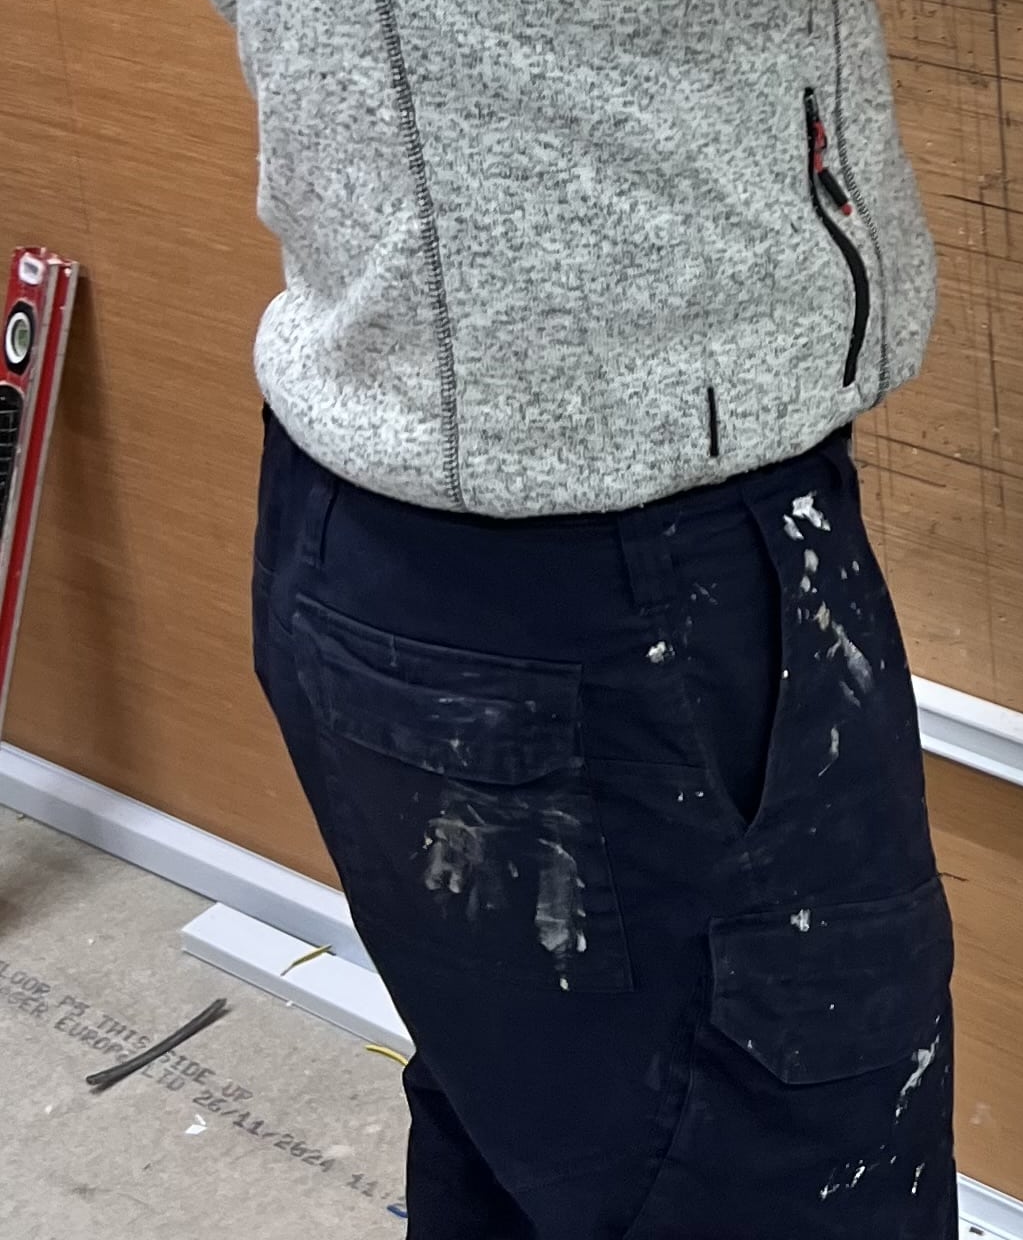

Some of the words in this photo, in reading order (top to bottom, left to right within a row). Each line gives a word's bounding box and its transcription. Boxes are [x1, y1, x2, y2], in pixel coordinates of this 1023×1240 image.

[0, 960, 51, 995] LOOR
[97, 1014, 150, 1050] THIS
[222, 1081, 253, 1101] UP
